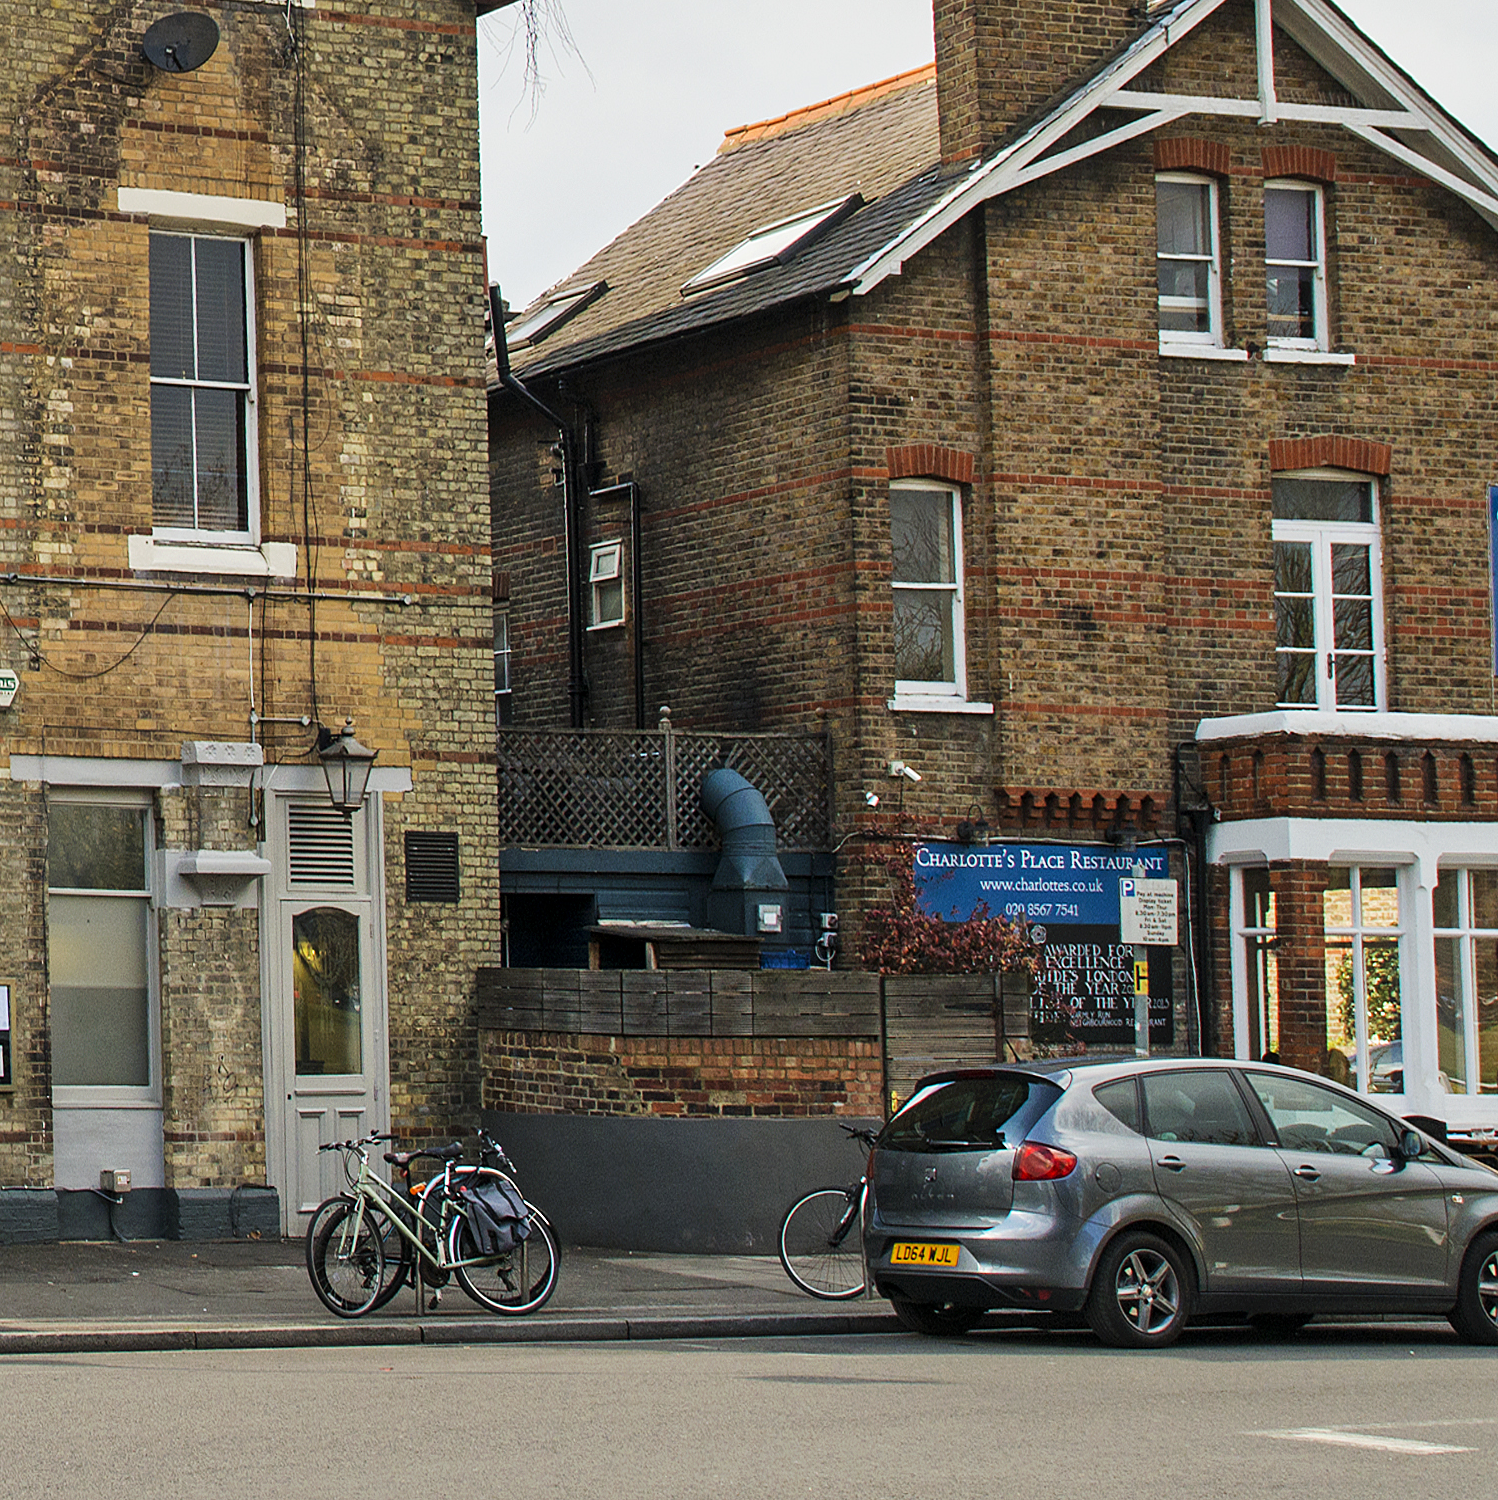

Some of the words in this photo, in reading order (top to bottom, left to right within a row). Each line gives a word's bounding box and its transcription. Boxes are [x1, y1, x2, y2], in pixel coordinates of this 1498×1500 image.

[916, 848, 1015, 869] CHARLOTTE'S
[1021, 850, 1065, 869] PLACE
[1070, 850, 1164, 871] RESTAURANT
[980, 877, 1103, 893] www.charlottes.co.uk
[1123, 880, 1134, 896] P
[1006, 903, 1025, 916] 020
[1027, 903, 1052, 916] 8567
[1055, 903, 1079, 917] 7541
[1044, 944, 1101, 957] AWARDED
[1108, 944, 1133, 957] FOR
[1045, 956, 1125, 969] EXCELLENCE
[1086, 970, 1134, 983] LONDON
[1053, 982, 1078, 995] THE
[1085, 982, 1120, 995] YEAR
[1070, 996, 1086, 1009] OF
[1094, 996, 1118, 1009] THE
[1126, 1018, 1166, 1027] RERANT
[896, 1246, 925, 1261] LD64
[928, 1247, 951, 1263] WJL
